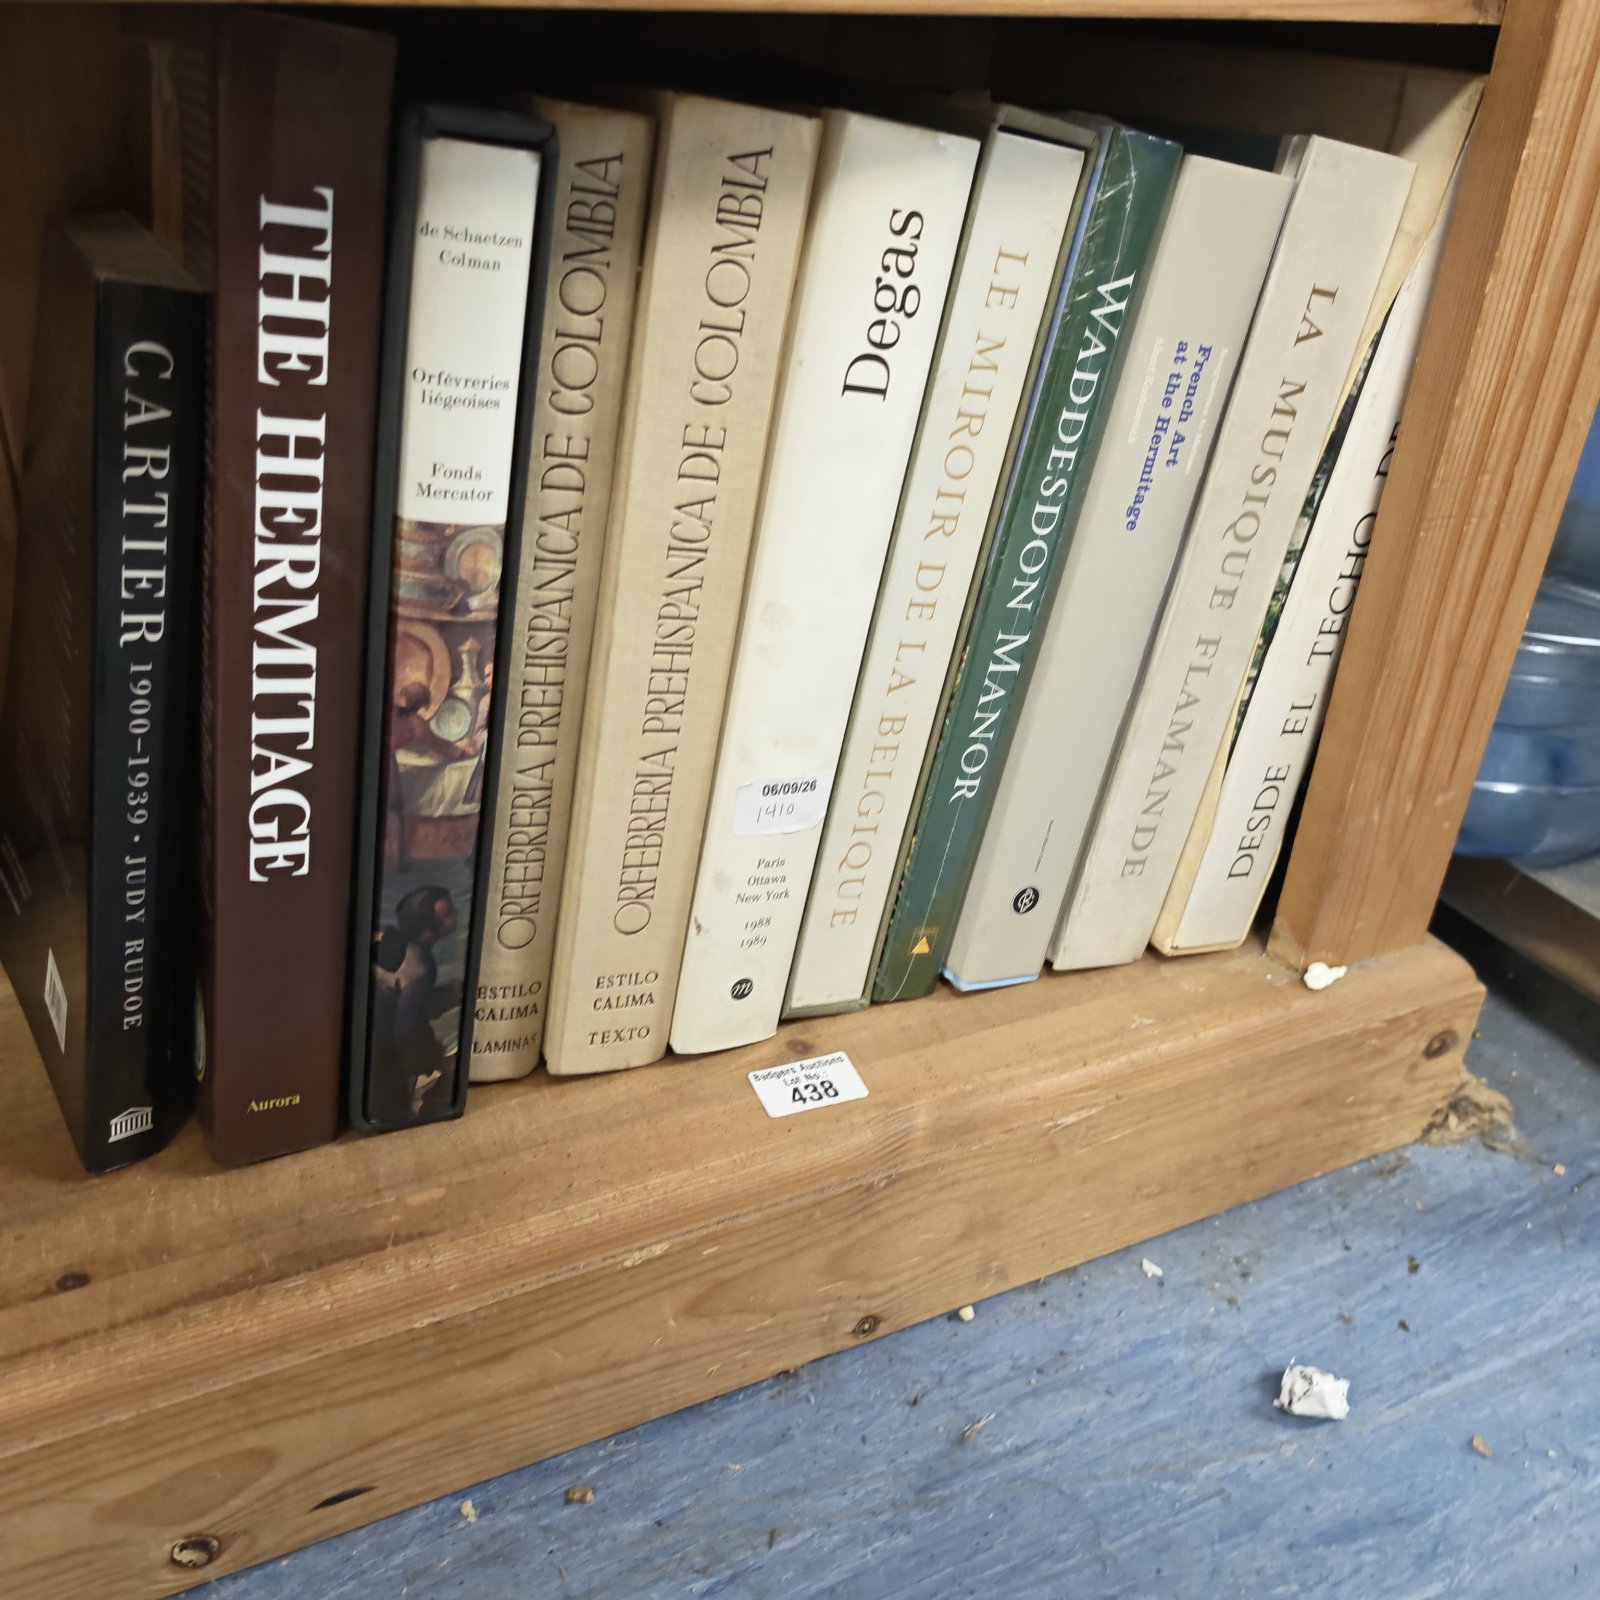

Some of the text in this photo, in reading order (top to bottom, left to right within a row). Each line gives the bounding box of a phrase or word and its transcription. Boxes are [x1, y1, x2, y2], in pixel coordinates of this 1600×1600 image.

[420, 221, 523, 248] de Schaetzen
[439, 249, 501, 271] Colman
[841, 207, 924, 402] Degas
[1173, 340, 1189, 365] at
[1161, 372, 1183, 409] the
[1178, 343, 1213, 424] French
[1165, 430, 1186, 468] Art
[430, 462, 482, 481] Fonds
[1126, 415, 1171, 532] Hermitage
[120, 340, 174, 648] CARTIER
[416, 482, 494, 502] Mercator
[248, 185, 334, 883] THE HERMITAGE
[613, 145, 774, 936] ORFEBRERIA PREHISPANICA DE COLOMBIA
[949, 272, 1133, 804] WADDESDON MANOR
[497, 153, 624, 950] ORFEBRERIA PREHISPANICA DE COLOMBIA
[830, 245, 1029, 929] LE MIROIR DE LA BELGIQUE
[1121, 282, 1340, 878] LA MUSIQUE FLAMANDE
[1227, 763, 1291, 880] DESDE
[1280, 692, 1317, 737] EL
[1306, 512, 1378, 666] TECHO
[762, 779, 818, 797] 06/09/26
[756, 856, 785, 870] Paris
[124, 855, 147, 923] JUDY
[747, 875, 787, 887] Ottawa
[735, 888, 790, 904] New York
[744, 916, 771, 930] 1988
[740, 935, 767, 950] 1989
[123, 937, 145, 1030] RUDOE
[477, 980, 542, 1000] ESTILO
[595, 970, 659, 990] ESTILO
[474, 1002, 539, 1022] CALIMA
[592, 992, 655, 1012] CALIMA
[588, 1025, 650, 1047] TEXTO
[800, 1056, 844, 1071] Auctions
[783, 1075, 801, 1087] Lot
[791, 1079, 839, 1104] 438
[246, 1094, 301, 1114] Aurora
